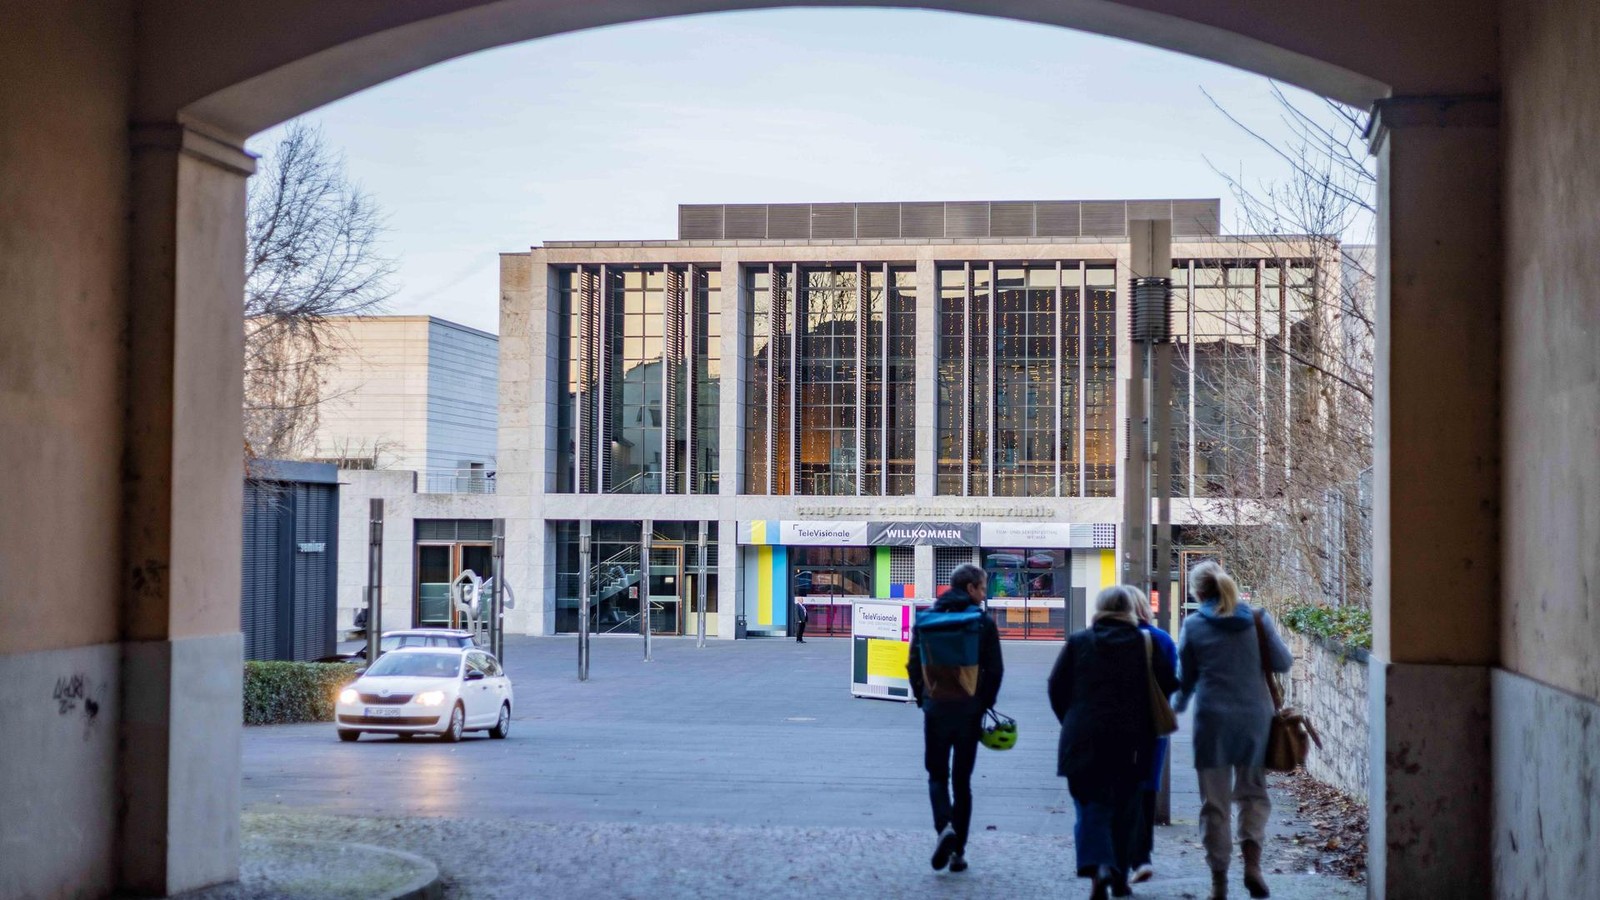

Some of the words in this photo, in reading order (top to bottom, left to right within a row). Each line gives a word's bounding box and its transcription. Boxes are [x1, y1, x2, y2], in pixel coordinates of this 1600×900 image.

[797, 506, 870, 518] congress
[799, 529, 850, 538] TeleVisionale
[886, 529, 962, 539] WILLKOMMEN
[862, 612, 898, 622] TeleVisionale
